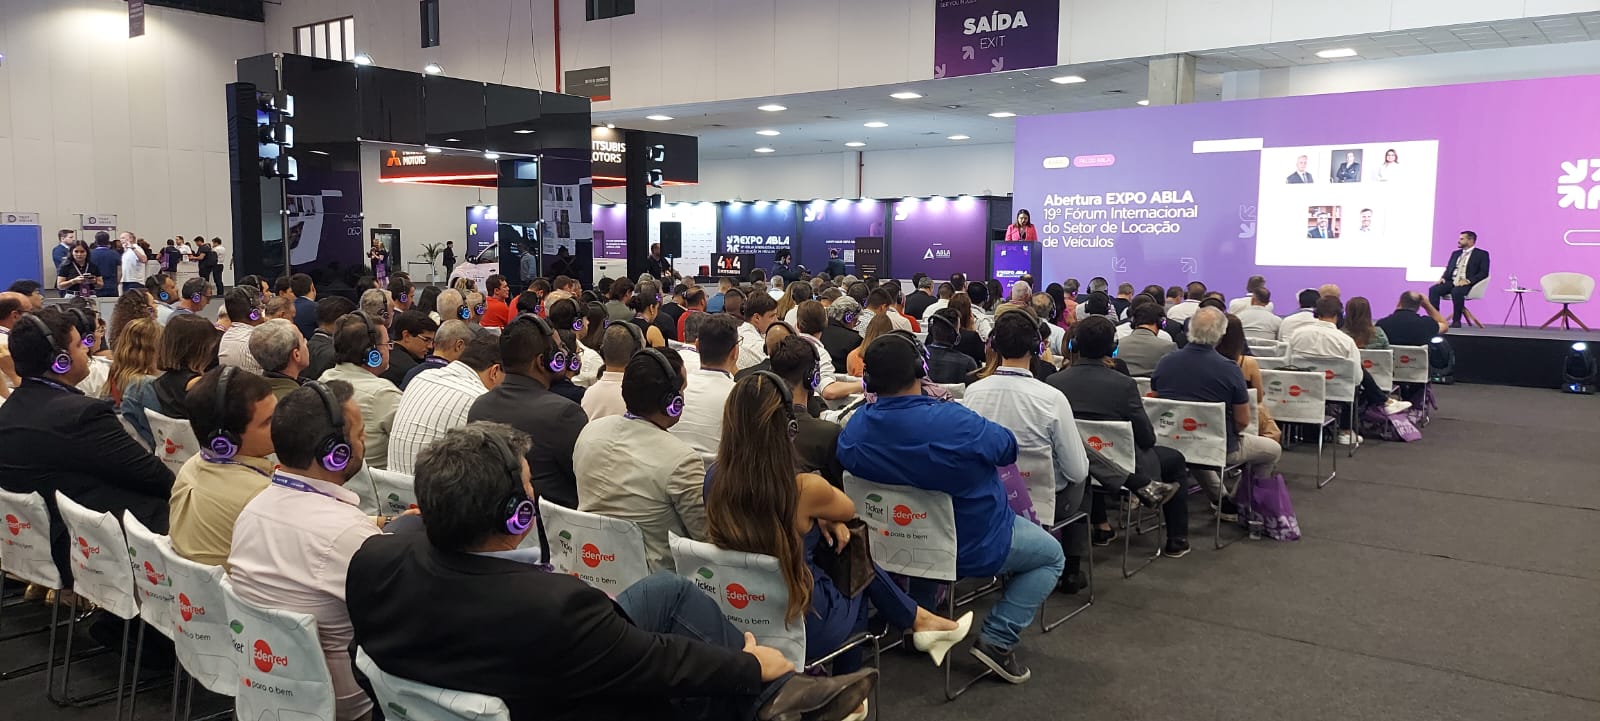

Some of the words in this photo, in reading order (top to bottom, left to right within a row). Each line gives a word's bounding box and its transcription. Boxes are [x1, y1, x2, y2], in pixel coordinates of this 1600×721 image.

[963, 10, 1028, 35] SAÍDA
[980, 35, 1006, 49] EXIT
[592, 140, 627, 152] ITSUBIS
[402, 155, 426, 166] MOTORS
[592, 151, 622, 163] OTORS
[1043, 193, 1103, 207] Abertura
[1105, 192, 1147, 205] EXPO
[1150, 190, 1195, 204] ABLA
[1043, 207, 1062, 221] 19º
[1064, 206, 1107, 220] Fórum
[1111, 205, 1199, 219] Internacional
[1043, 221, 1060, 234] do
[1063, 221, 1098, 235] Setor
[1100, 221, 1118, 234] de
[1121, 220, 1181, 235] Locação
[740, 235, 763, 245] EXPO
[765, 235, 790, 245] ABLA
[1042, 235, 1059, 248] de
[1062, 235, 1115, 248] Veículos
[865, 502, 884, 516] Ticket
[893, 509, 928, 520] Edenred
[581, 548, 616, 562] Edenred
[601, 576, 618, 585] bem
[725, 589, 766, 602] Edenred
[751, 616, 770, 625] bem
[253, 646, 289, 667] Edenred
[252, 680, 268, 691] para
[275, 685, 294, 697] bem
